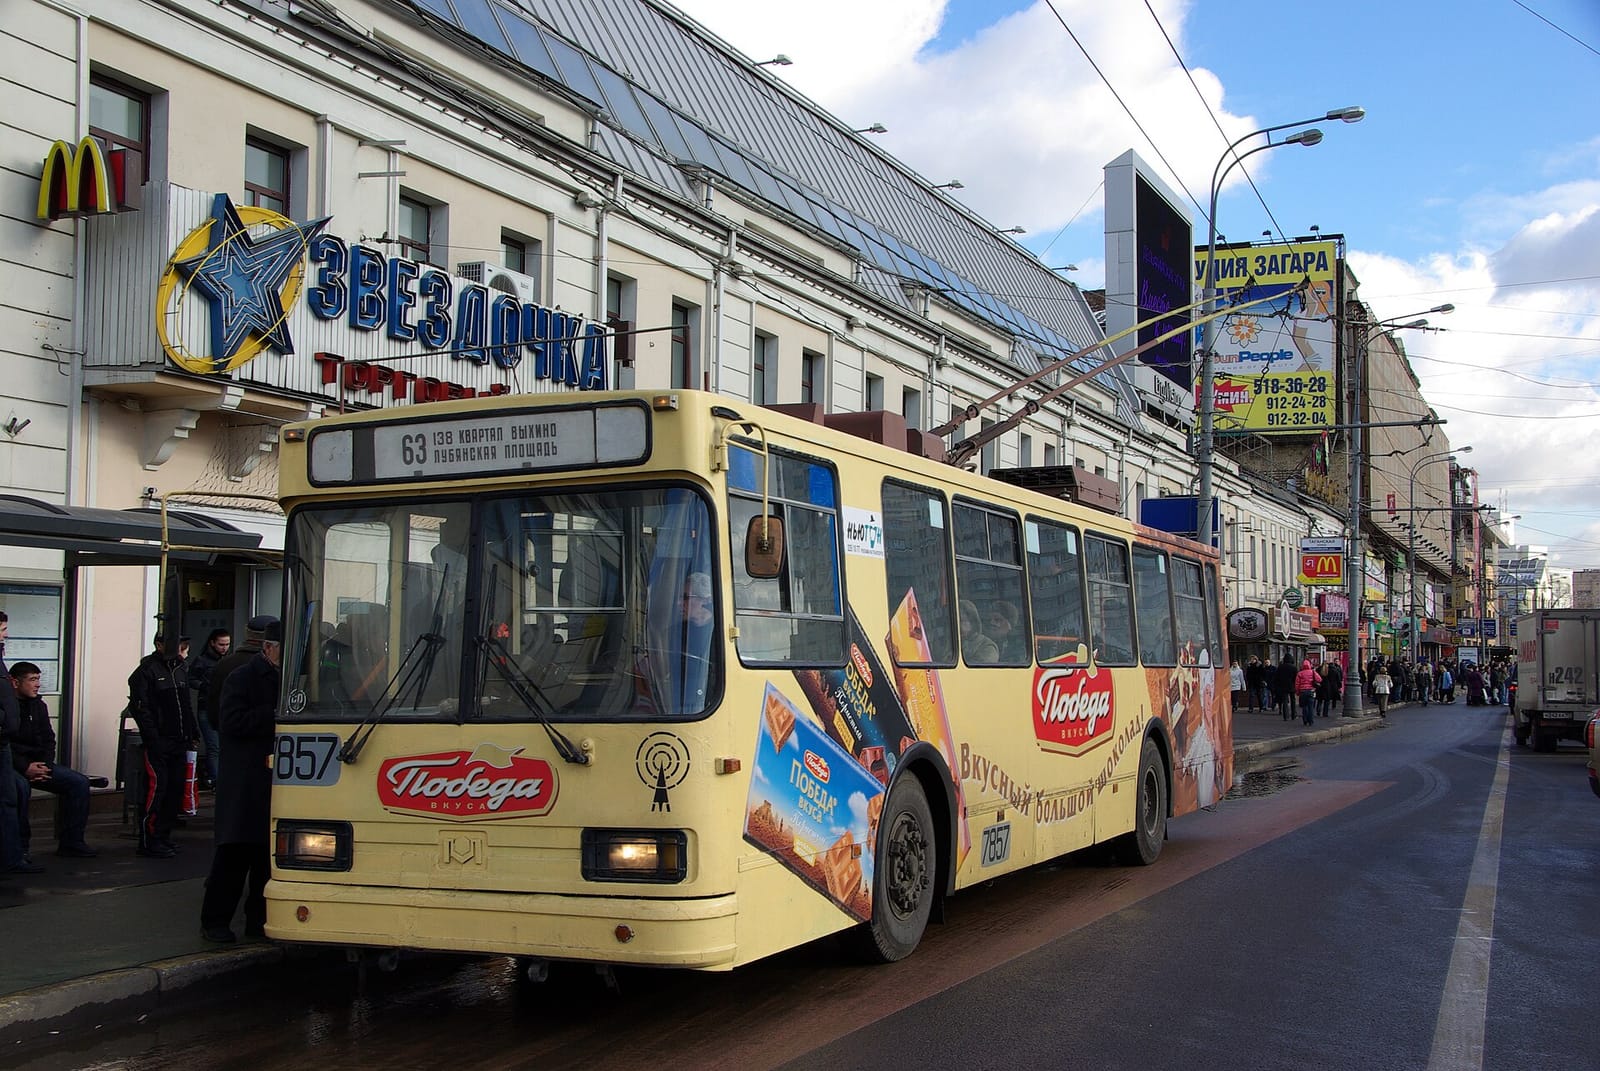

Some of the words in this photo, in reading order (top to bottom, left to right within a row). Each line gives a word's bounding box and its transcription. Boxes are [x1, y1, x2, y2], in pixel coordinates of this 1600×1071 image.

[1254, 251, 1329, 276] ЗАГАРА
[308, 234, 609, 391] ЗВЕЗДОЧКА
[314, 352, 511, 403] ТОРГОВ
[1253, 376, 1327, 395] 518-36-28
[1266, 396, 1327, 410] 912-24-28
[1267, 411, 1327, 426] 912-32-04
[433, 431, 453, 446] 138
[458, 426, 503, 444] КВАРТАЛ
[511, 423, 558, 440] ВЫХИНО
[402, 433, 427, 466] 63
[434, 446, 497, 464] ЛУБЯНСКАЯ
[504, 441, 558, 459] ПЛОЩАДЬ
[845, 661, 874, 721] ОБЕДА
[1036, 667, 1111, 736] Победа
[1061, 727, 1089, 739] ВКУСА
[272, 735, 338, 781] 857
[386, 755, 544, 811] Победа
[430, 801, 487, 811] ВКУСА
[982, 825, 1010, 865] 7857
